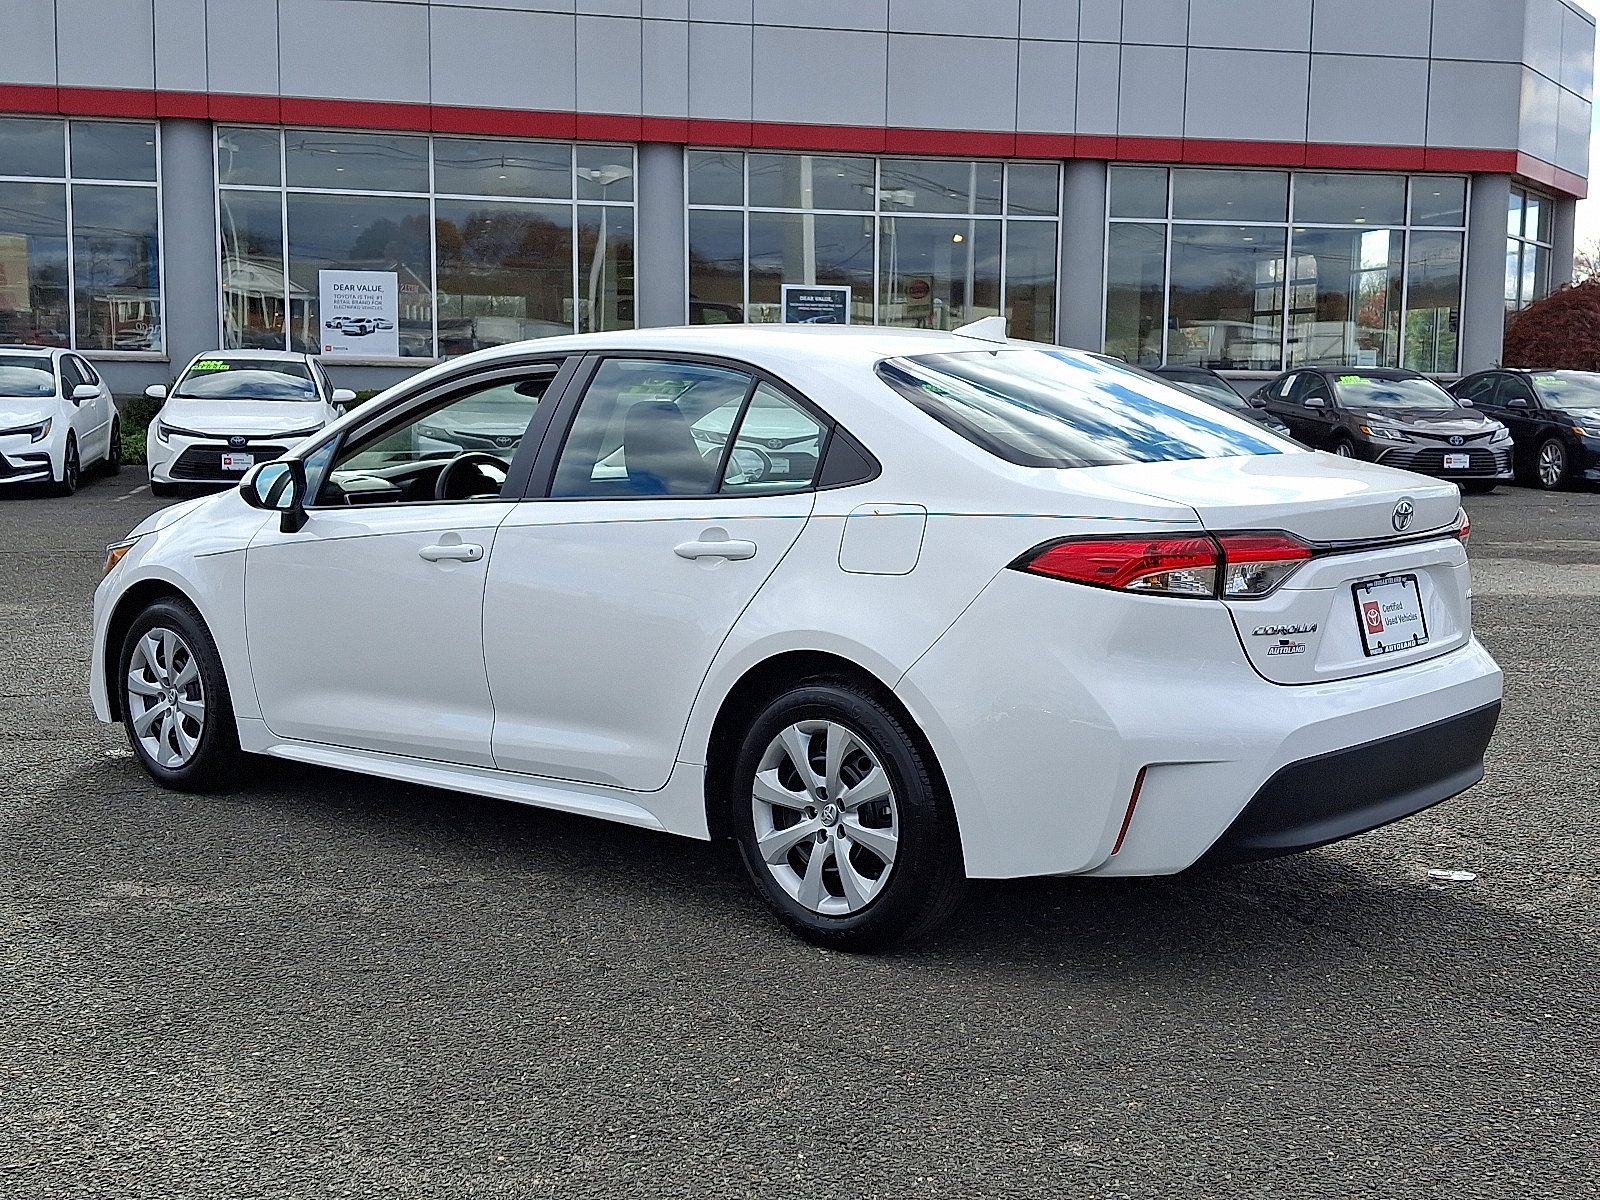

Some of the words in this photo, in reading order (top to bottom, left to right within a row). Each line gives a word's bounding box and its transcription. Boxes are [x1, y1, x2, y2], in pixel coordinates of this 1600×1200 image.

[356, 284, 384, 293] VALUE,
[1382, 601, 1403, 613] Certified
[1384, 616, 1398, 626] Used
[1397, 612, 1418, 624] Vehicles
[1252, 622, 1318, 636] COROLLA
[1267, 645, 1305, 656] AUTOLAND
[1385, 640, 1416, 653] AUTOLAND
